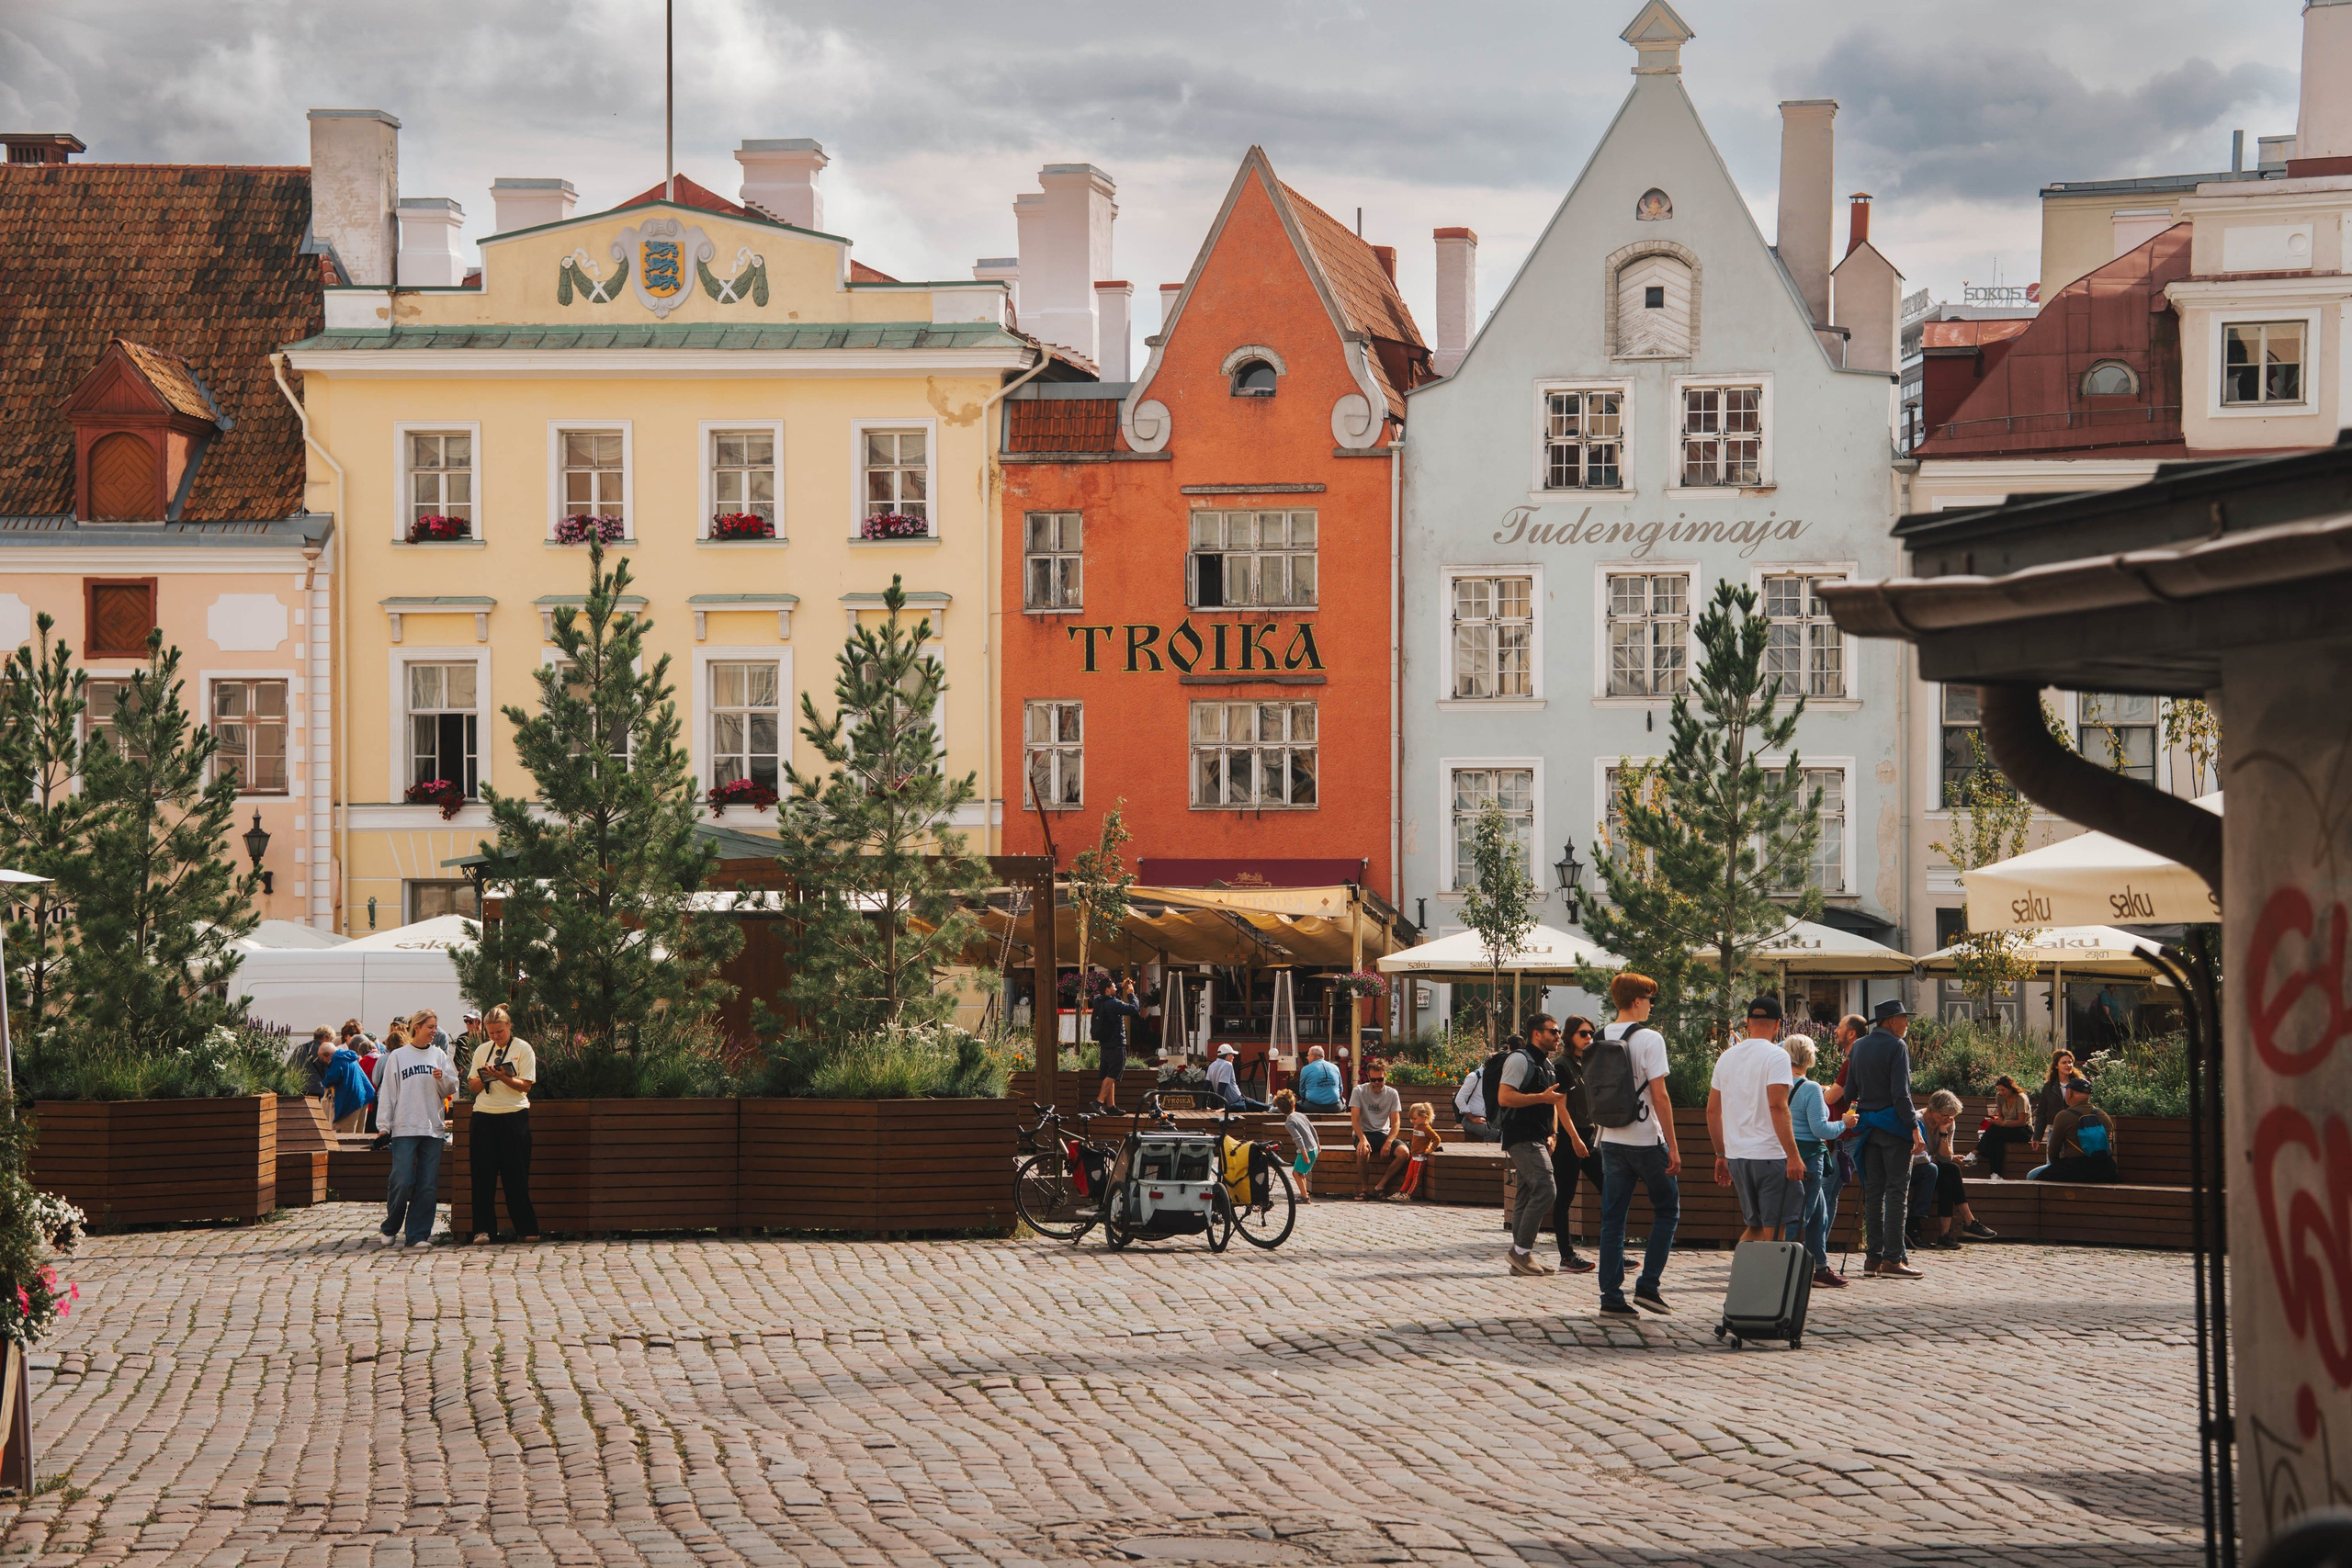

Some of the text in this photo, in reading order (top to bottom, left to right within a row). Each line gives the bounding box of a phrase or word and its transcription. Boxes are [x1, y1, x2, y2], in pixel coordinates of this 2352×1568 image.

[1493, 506, 1813, 558] Tudengimaja
[1066, 616, 1327, 675] TROIKA
[2012, 889, 2052, 923] saku
[2109, 885, 2155, 919] saku
[395, 940, 466, 950] saku
[2023, 938, 2100, 950] saku
[1408, 961, 1430, 970] saku
[401, 1065, 435, 1080] HAMILT
